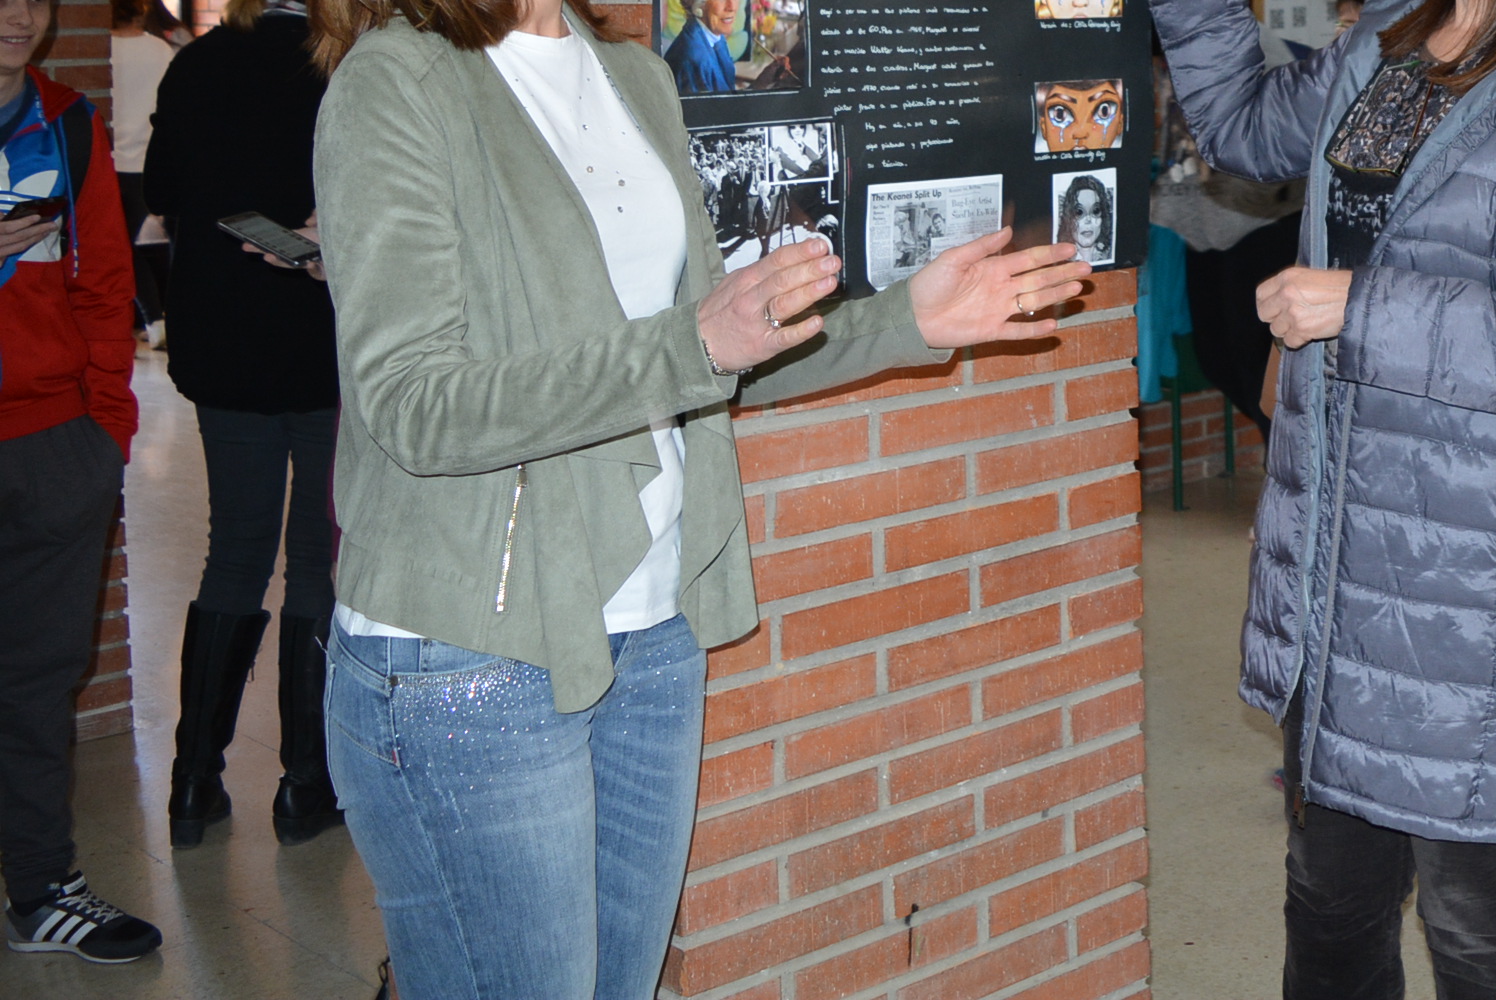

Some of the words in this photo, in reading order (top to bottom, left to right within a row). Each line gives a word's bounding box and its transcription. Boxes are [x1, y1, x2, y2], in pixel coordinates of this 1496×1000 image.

[870, 45, 893, 55] Walter
[871, 193, 885, 202] The
[887, 191, 913, 201] Keanes
[914, 189, 930, 200] Split
[932, 188, 942, 199] Up
